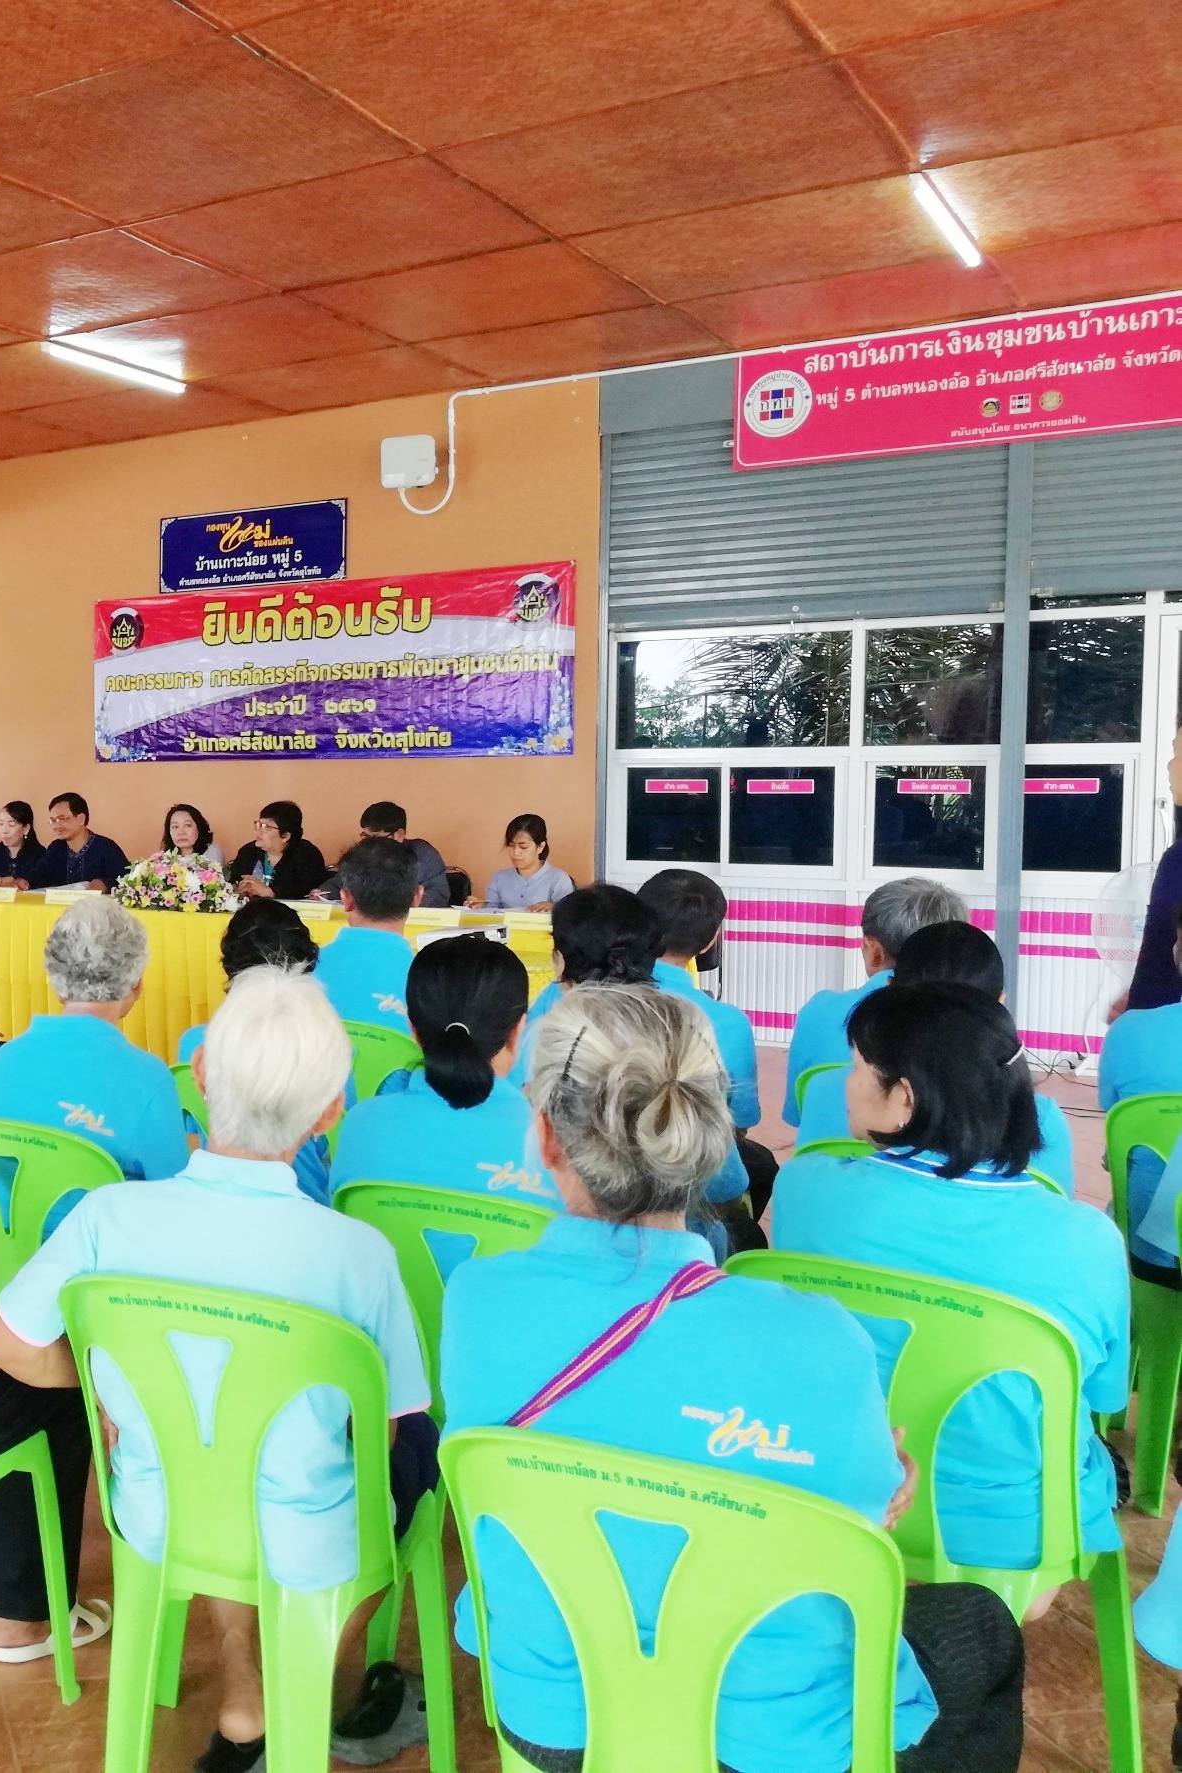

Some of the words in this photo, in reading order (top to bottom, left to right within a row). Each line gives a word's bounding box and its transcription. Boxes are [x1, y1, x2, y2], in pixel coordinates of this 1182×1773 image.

[815, 386, 838, 410] หมู่
[843, 390, 856, 403] 5
[861, 372, 970, 401] ตำบลหนองอ้อ
[975, 353, 1116, 387] อำเภอศรีสัชนาลัย
[1121, 344, 1182, 368] จังหวัด
[950, 422, 1011, 438] สนับสนุนโดย
[195, 551, 268, 572] บ้านเกาะน้อย
[272, 548, 290, 569] หมู่
[293, 549, 303, 563] 5
[201, 586, 433, 647] ยินดีต้อนรับ
[105, 671, 204, 693] คณะกรรมการ
[209, 645, 559, 688] การคัดสรรกิจกรรมการพัฒนาชุมชนดีเด่น
[244, 694, 307, 718] ประจำปี
[324, 698, 377, 715] ๒๕๖๑
[182, 729, 317, 753] อำเภอศรีสัชนาลัย
[334, 725, 453, 754] จังหวัดสุโขทัย
